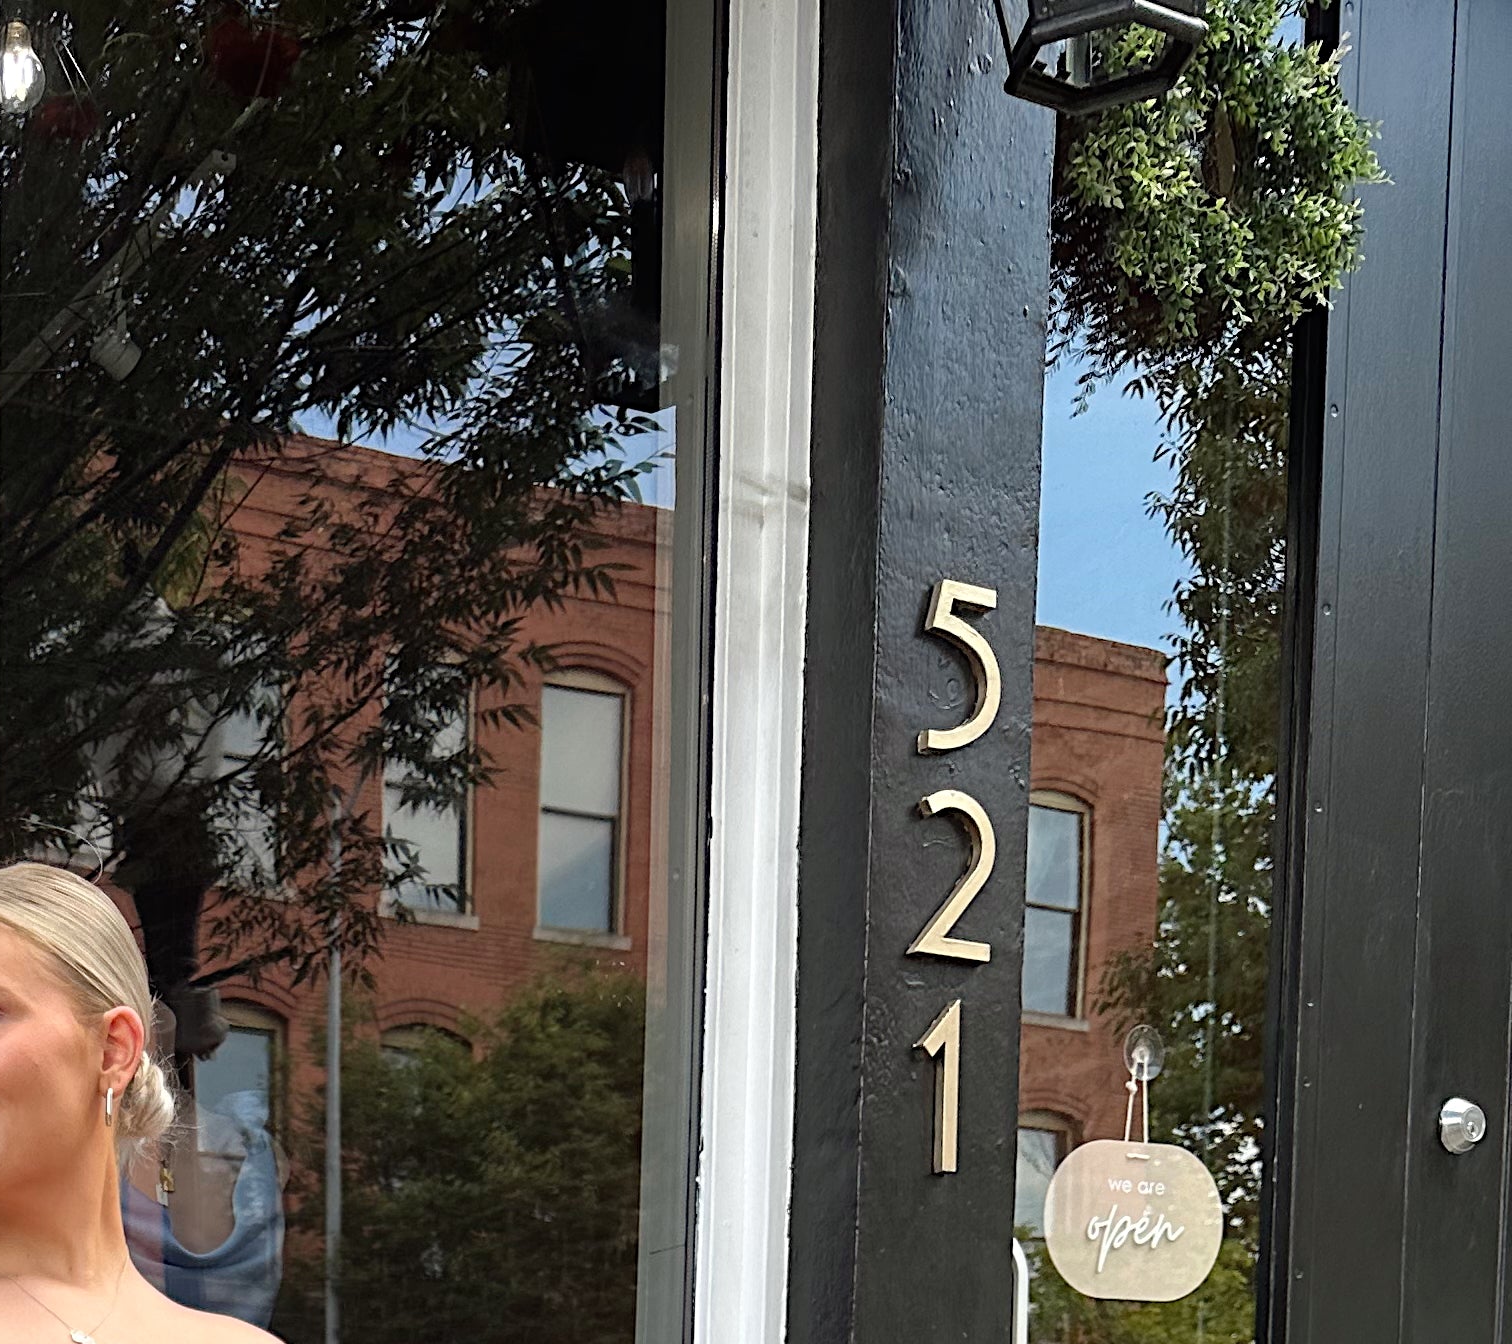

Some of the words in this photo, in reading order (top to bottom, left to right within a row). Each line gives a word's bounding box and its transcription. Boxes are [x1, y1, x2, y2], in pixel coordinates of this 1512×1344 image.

[906, 578, 1002, 1174] 521
[1109, 1178, 1132, 1193] we
[1138, 1180, 1165, 1195] are
[1088, 1204, 1185, 1273] open
